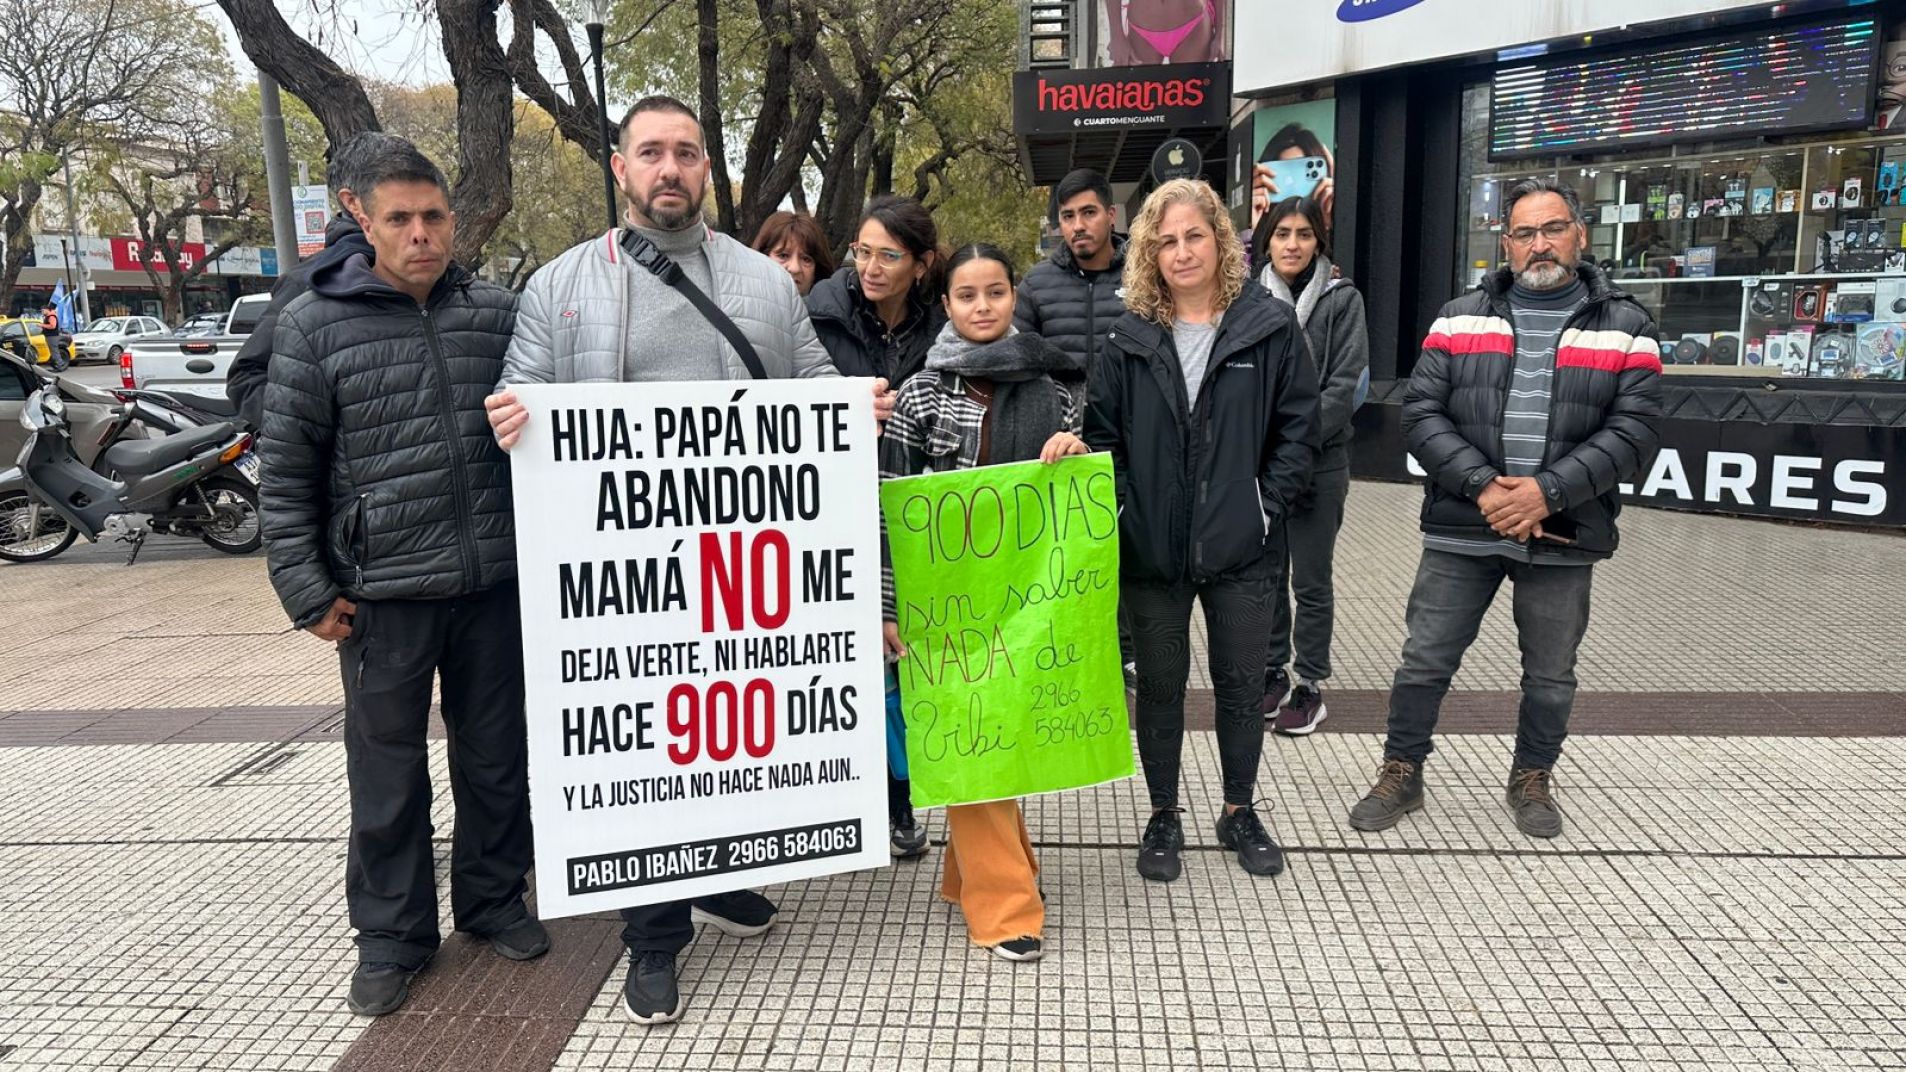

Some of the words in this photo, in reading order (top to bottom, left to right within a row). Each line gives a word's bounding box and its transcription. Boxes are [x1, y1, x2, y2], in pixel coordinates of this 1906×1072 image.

[1038, 78, 1204, 111] havaianas
[551, 408, 643, 461] HIJA:
[655, 389, 747, 458] PAPÁ
[757, 404, 801, 454] NO
[811, 403, 851, 452] TE
[597, 464, 820, 531] ABANDONO
[1618, 449, 1887, 515] ARES
[902, 485, 1004, 564] 900
[1015, 472, 1116, 550] DIAS
[560, 539, 688, 619] MAMÁ
[699, 529, 791, 633] NO
[803, 549, 855, 602] ME
[904, 594, 985, 634] sin
[1001, 546, 1109, 614] saber
[562, 647, 620, 682] DEJA
[627, 642, 708, 678] VERTE,
[716, 639, 737, 671] NI
[745, 631, 856, 669] HABLARTE
[906, 623, 1016, 690] NADA
[1036, 619, 1084, 671] de
[563, 702, 655, 756] HACE
[667, 678, 775, 765] 900
[788, 675, 858, 735] DÍAS
[1031, 681, 1080, 713] 2966
[1035, 706, 1114, 748] 584063
[563, 786, 575, 811] Y
[581, 784, 604, 809] LA
[609, 774, 685, 807] JUSTICIA
[691, 772, 714, 798] NO
[720, 767, 764, 794] HACE
[769, 762, 814, 789] NADA
[818, 758, 860, 784] AUN..
[573, 857, 640, 889] PABLO
[646, 845, 718, 879] IBAÑEZ
[728, 837, 779, 867] 2966
[785, 825, 857, 857] 584063
